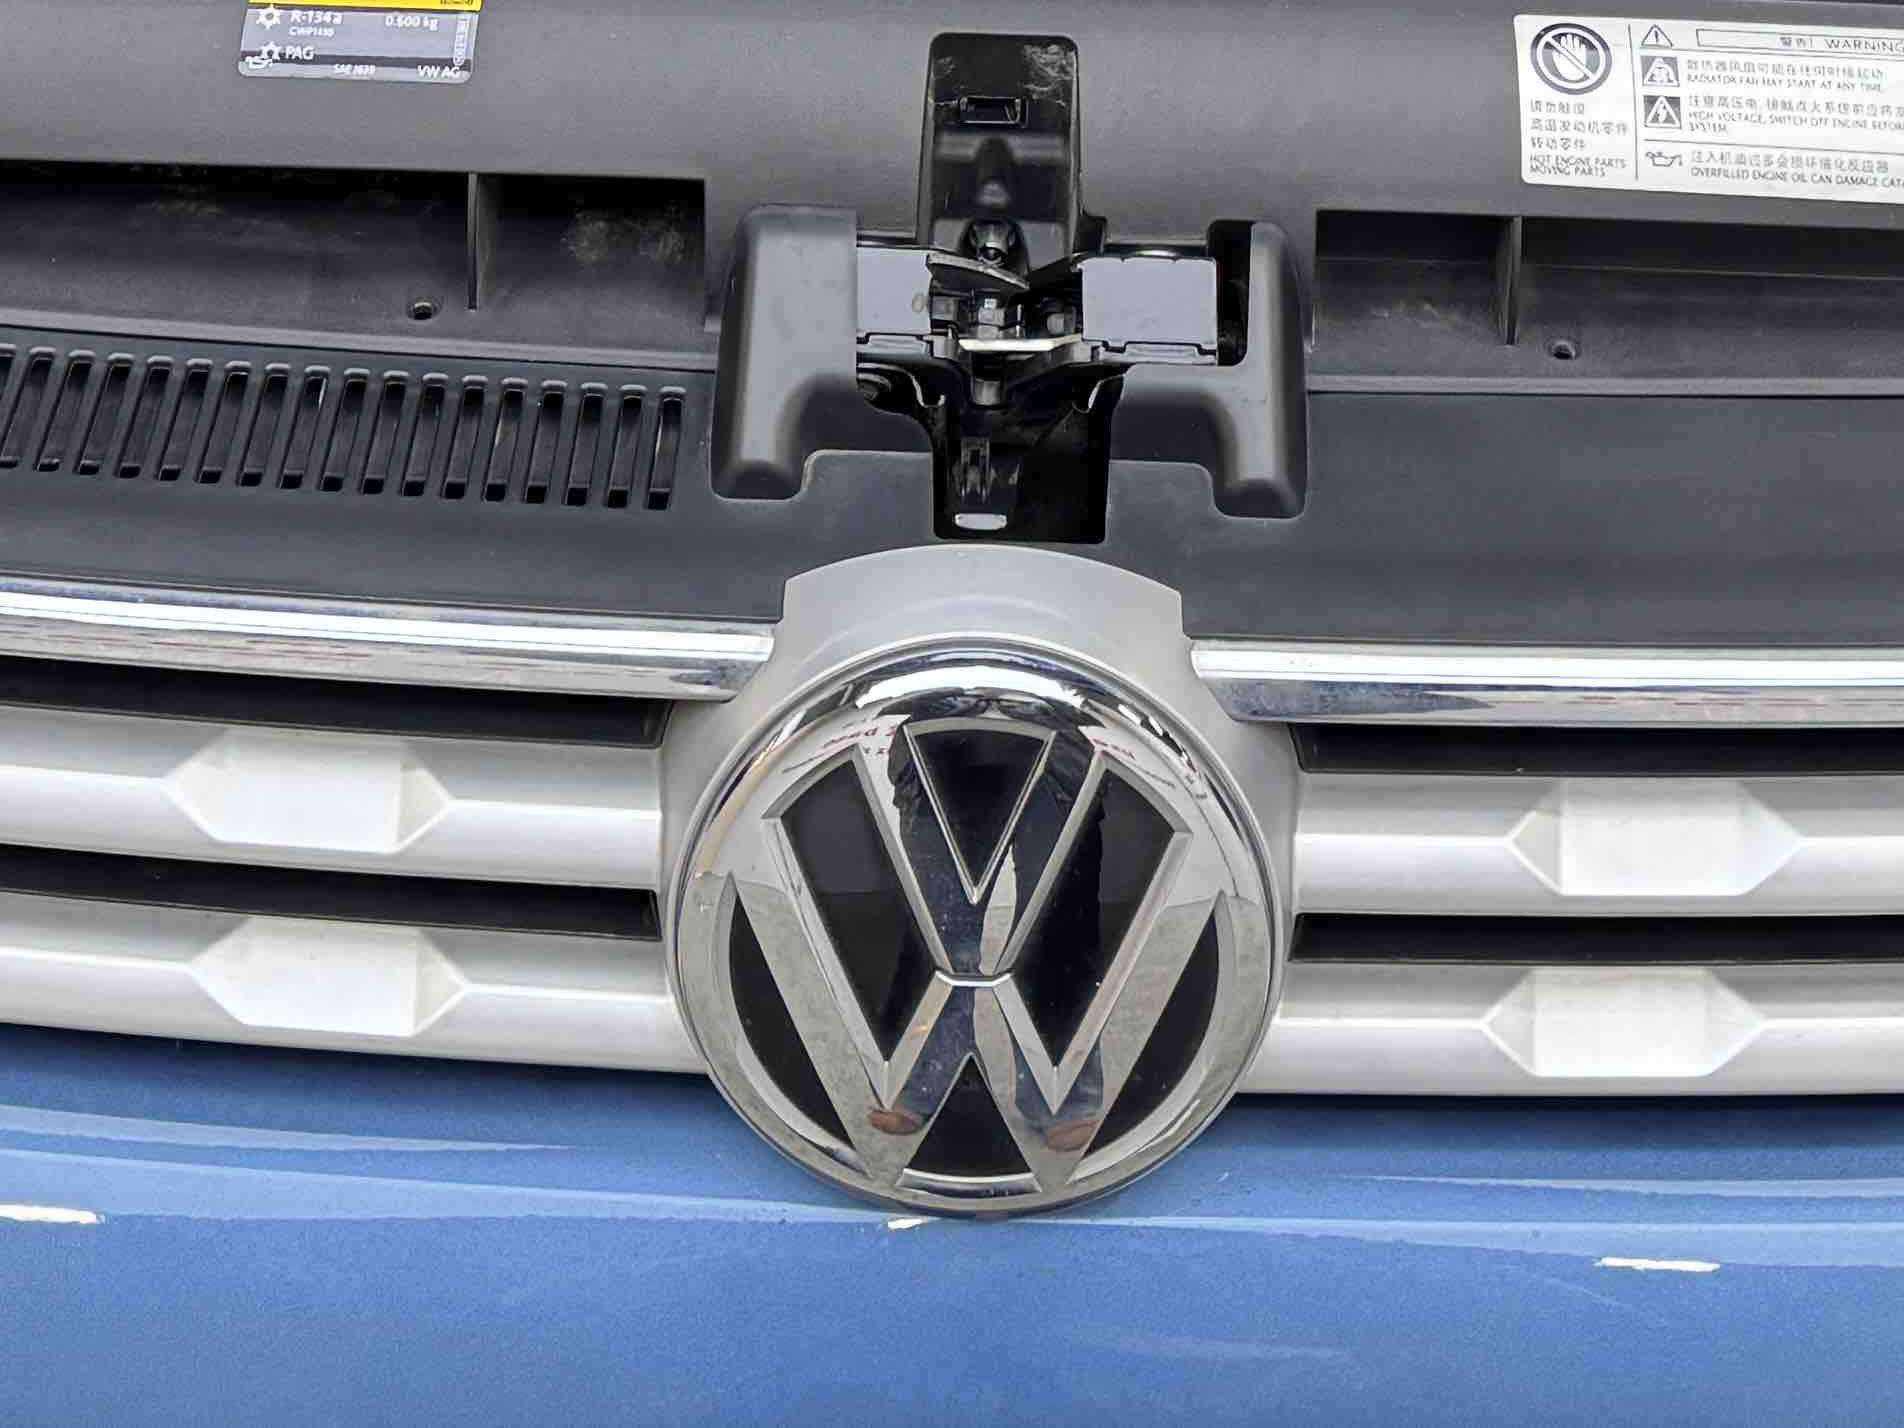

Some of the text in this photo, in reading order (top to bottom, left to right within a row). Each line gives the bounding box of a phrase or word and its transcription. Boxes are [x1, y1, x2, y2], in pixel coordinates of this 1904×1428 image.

[286, 46, 315, 60] PAG
[417, 65, 461, 79] VW AG
[1690, 167, 1749, 180] OVERFILLED
[1810, 174, 1833, 184] CAN
